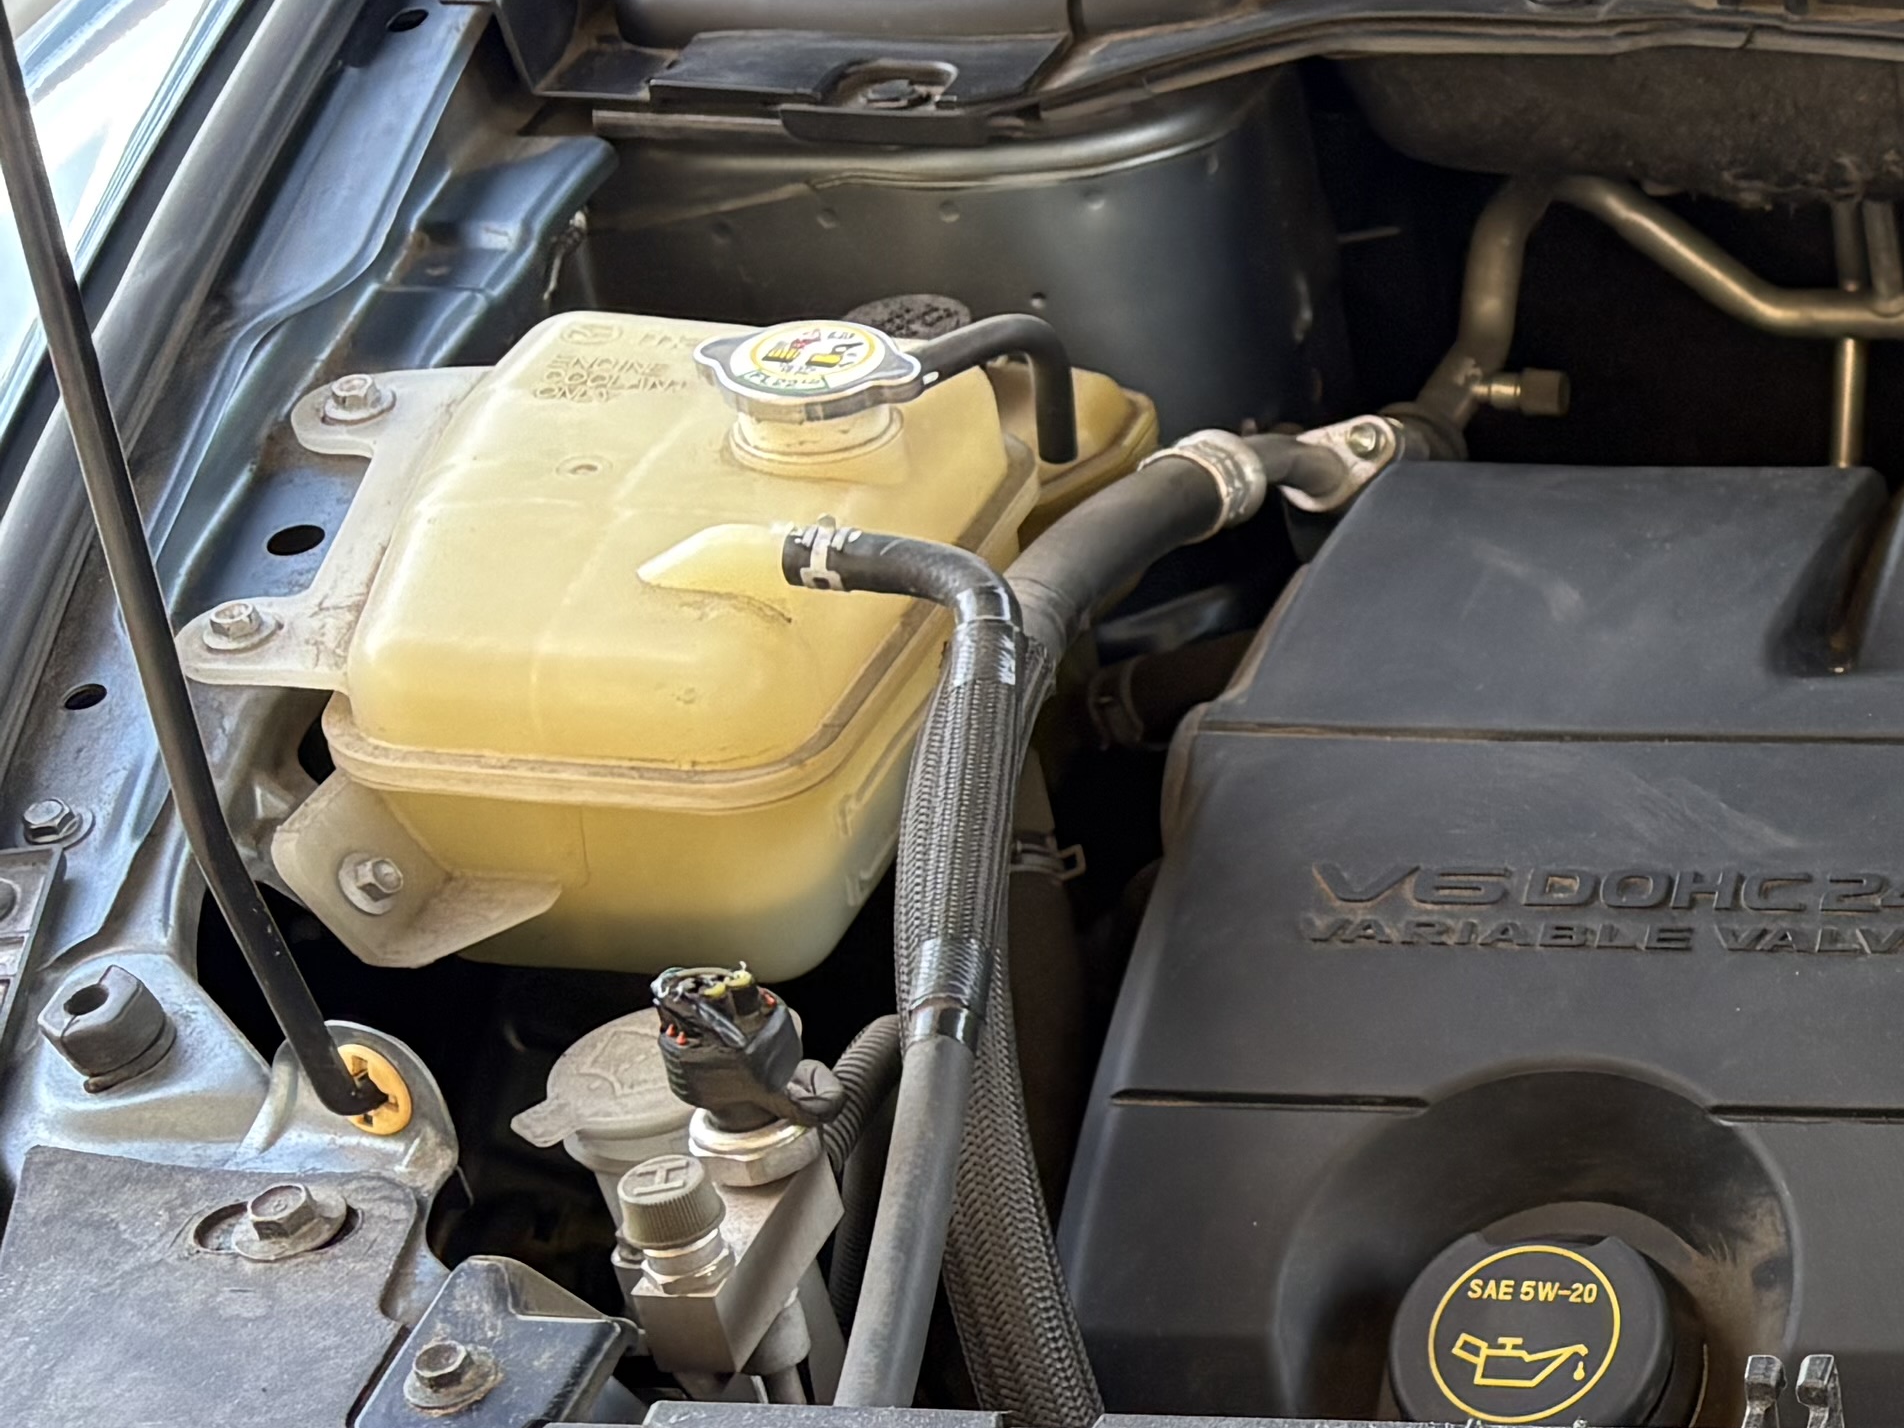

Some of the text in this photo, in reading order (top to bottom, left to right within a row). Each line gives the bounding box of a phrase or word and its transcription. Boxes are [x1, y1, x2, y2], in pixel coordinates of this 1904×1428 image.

[1312, 864, 1512, 908] V6
[1522, 868, 1812, 913] DOHC
[1309, 918, 1694, 952] VARIABLE
[1467, 1278, 1598, 1304] SAE 5W-20
